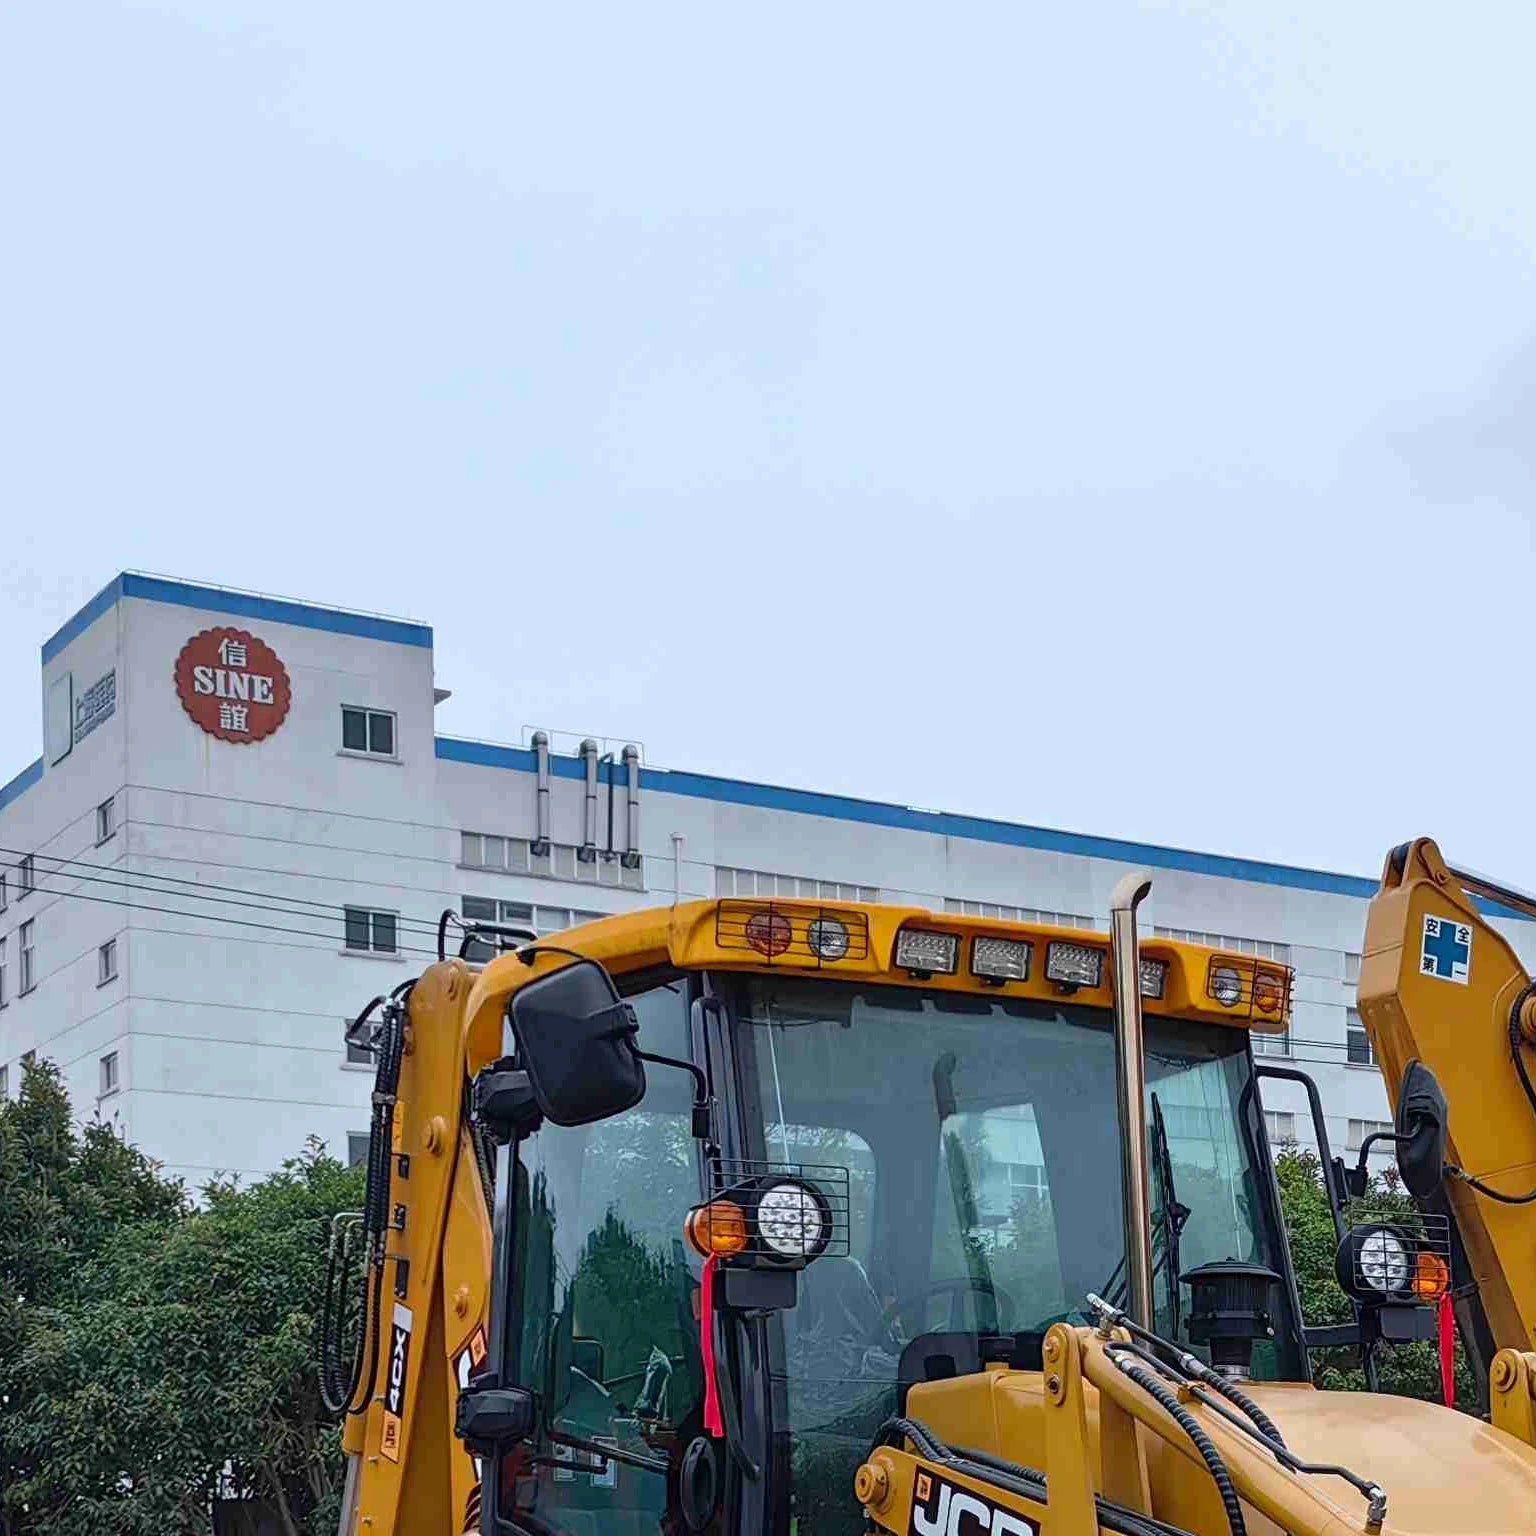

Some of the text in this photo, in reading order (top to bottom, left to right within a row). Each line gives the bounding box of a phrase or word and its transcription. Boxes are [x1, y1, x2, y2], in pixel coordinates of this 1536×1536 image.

[218, 638, 247, 668] 信
[193, 665, 275, 705] SINE
[389, 1328, 407, 1412] 4CX
